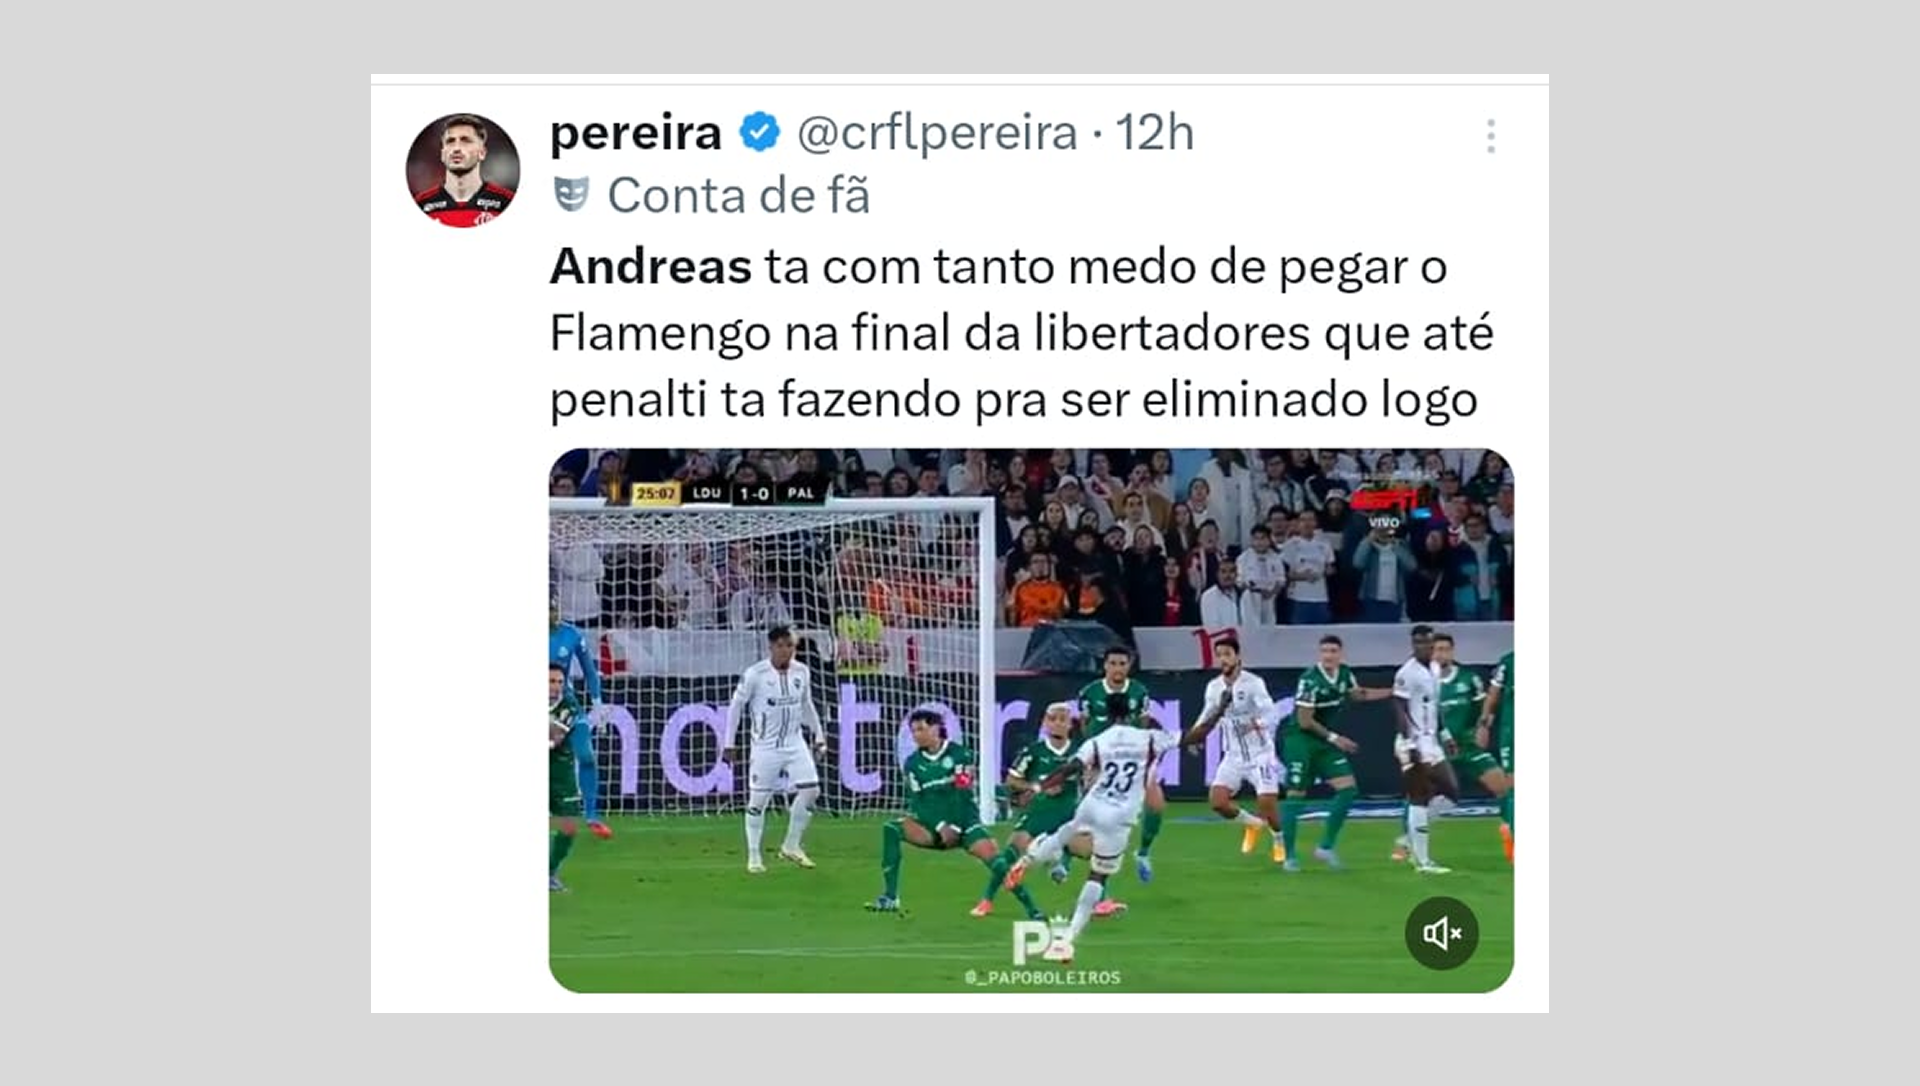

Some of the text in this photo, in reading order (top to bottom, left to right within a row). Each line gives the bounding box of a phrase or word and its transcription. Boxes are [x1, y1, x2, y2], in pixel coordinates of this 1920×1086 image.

[549, 111, 1194, 159] pereira @crflpereira 12h
[608, 173, 870, 214] Conta de fã
[549, 244, 1447, 293] Andreas ta com tanto medo de pegar o
[552, 310, 1494, 361] Flamengo na final da libertadores que até
[551, 377, 1478, 427] penalti ta fazendo pra ser eliminado logo
[1100, 761, 1139, 794] 33
